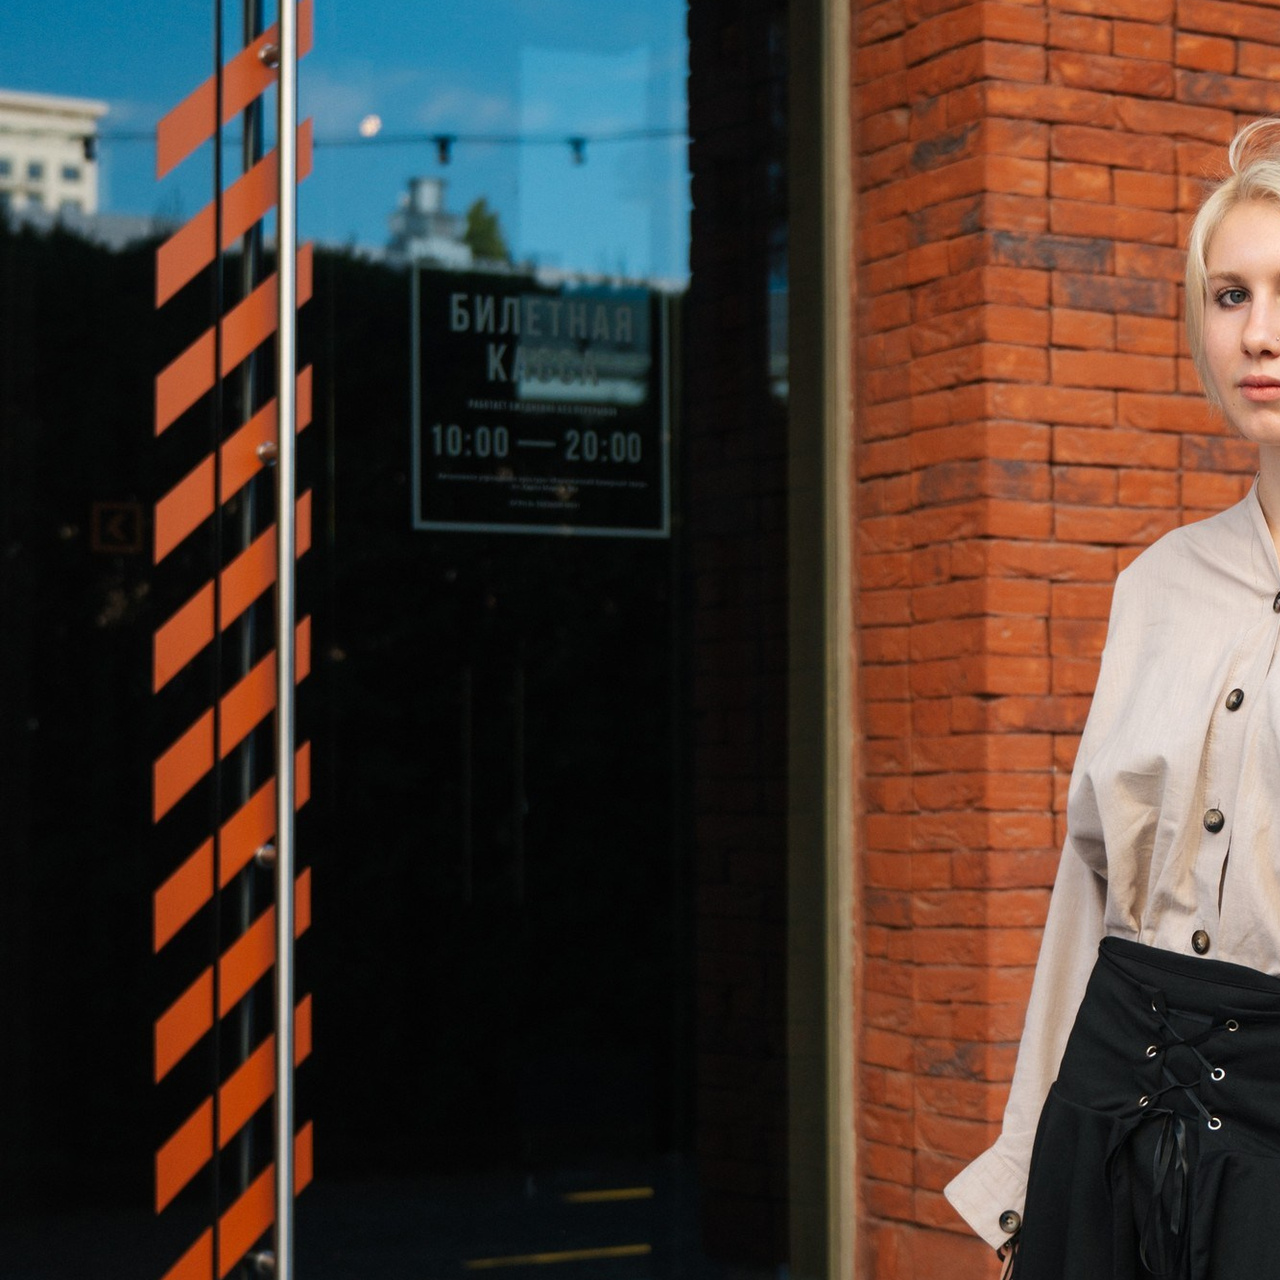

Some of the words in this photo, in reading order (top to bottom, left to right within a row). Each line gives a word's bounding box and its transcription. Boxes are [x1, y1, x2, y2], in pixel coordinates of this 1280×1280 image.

[449, 292, 634, 343] БИЛЕТНАЯ
[486, 342, 600, 386] КАССА
[432, 423, 510, 458] 10:00
[564, 429, 643, 464] 20:00
